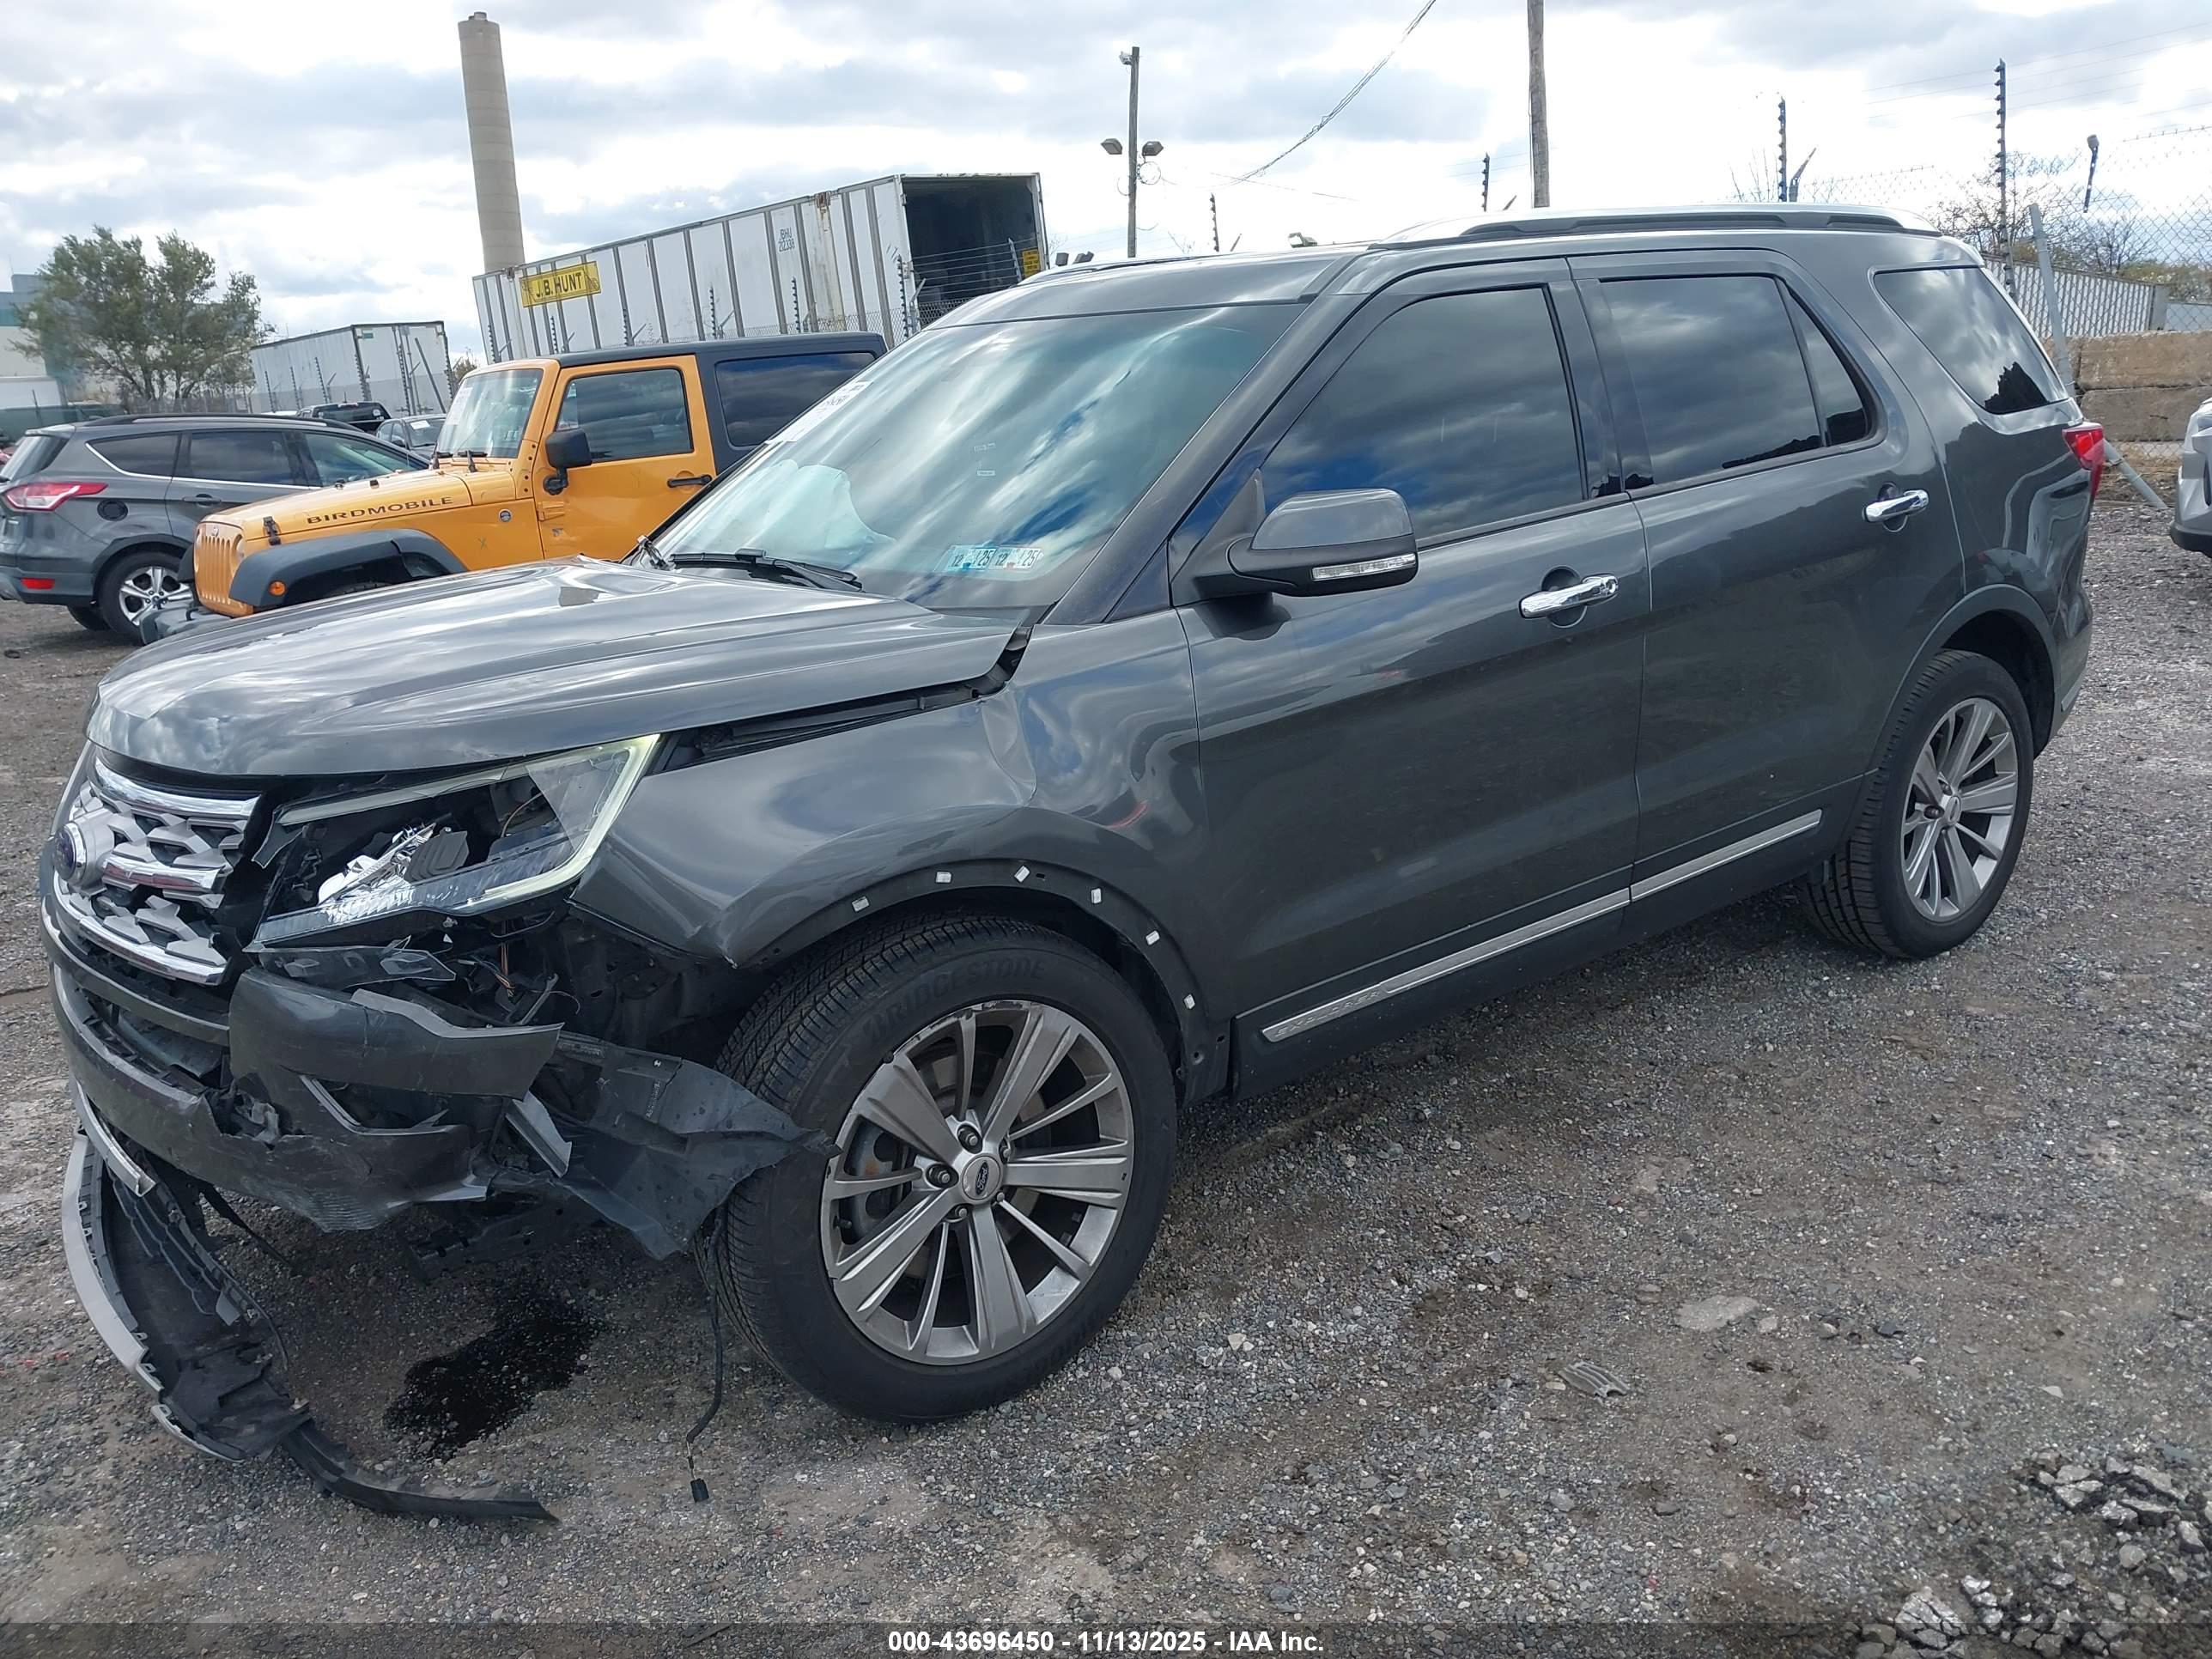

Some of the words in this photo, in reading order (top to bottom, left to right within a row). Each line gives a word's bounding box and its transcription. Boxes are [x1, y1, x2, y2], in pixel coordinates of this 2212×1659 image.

[536, 279, 553, 297] J.B.
[554, 272, 581, 293] HUNT
[307, 496, 453, 524] BIRDMOBILE
[951, 554, 963, 567] 12
[995, 553, 1008, 567] 12
[976, 1166, 988, 1191] Ford
